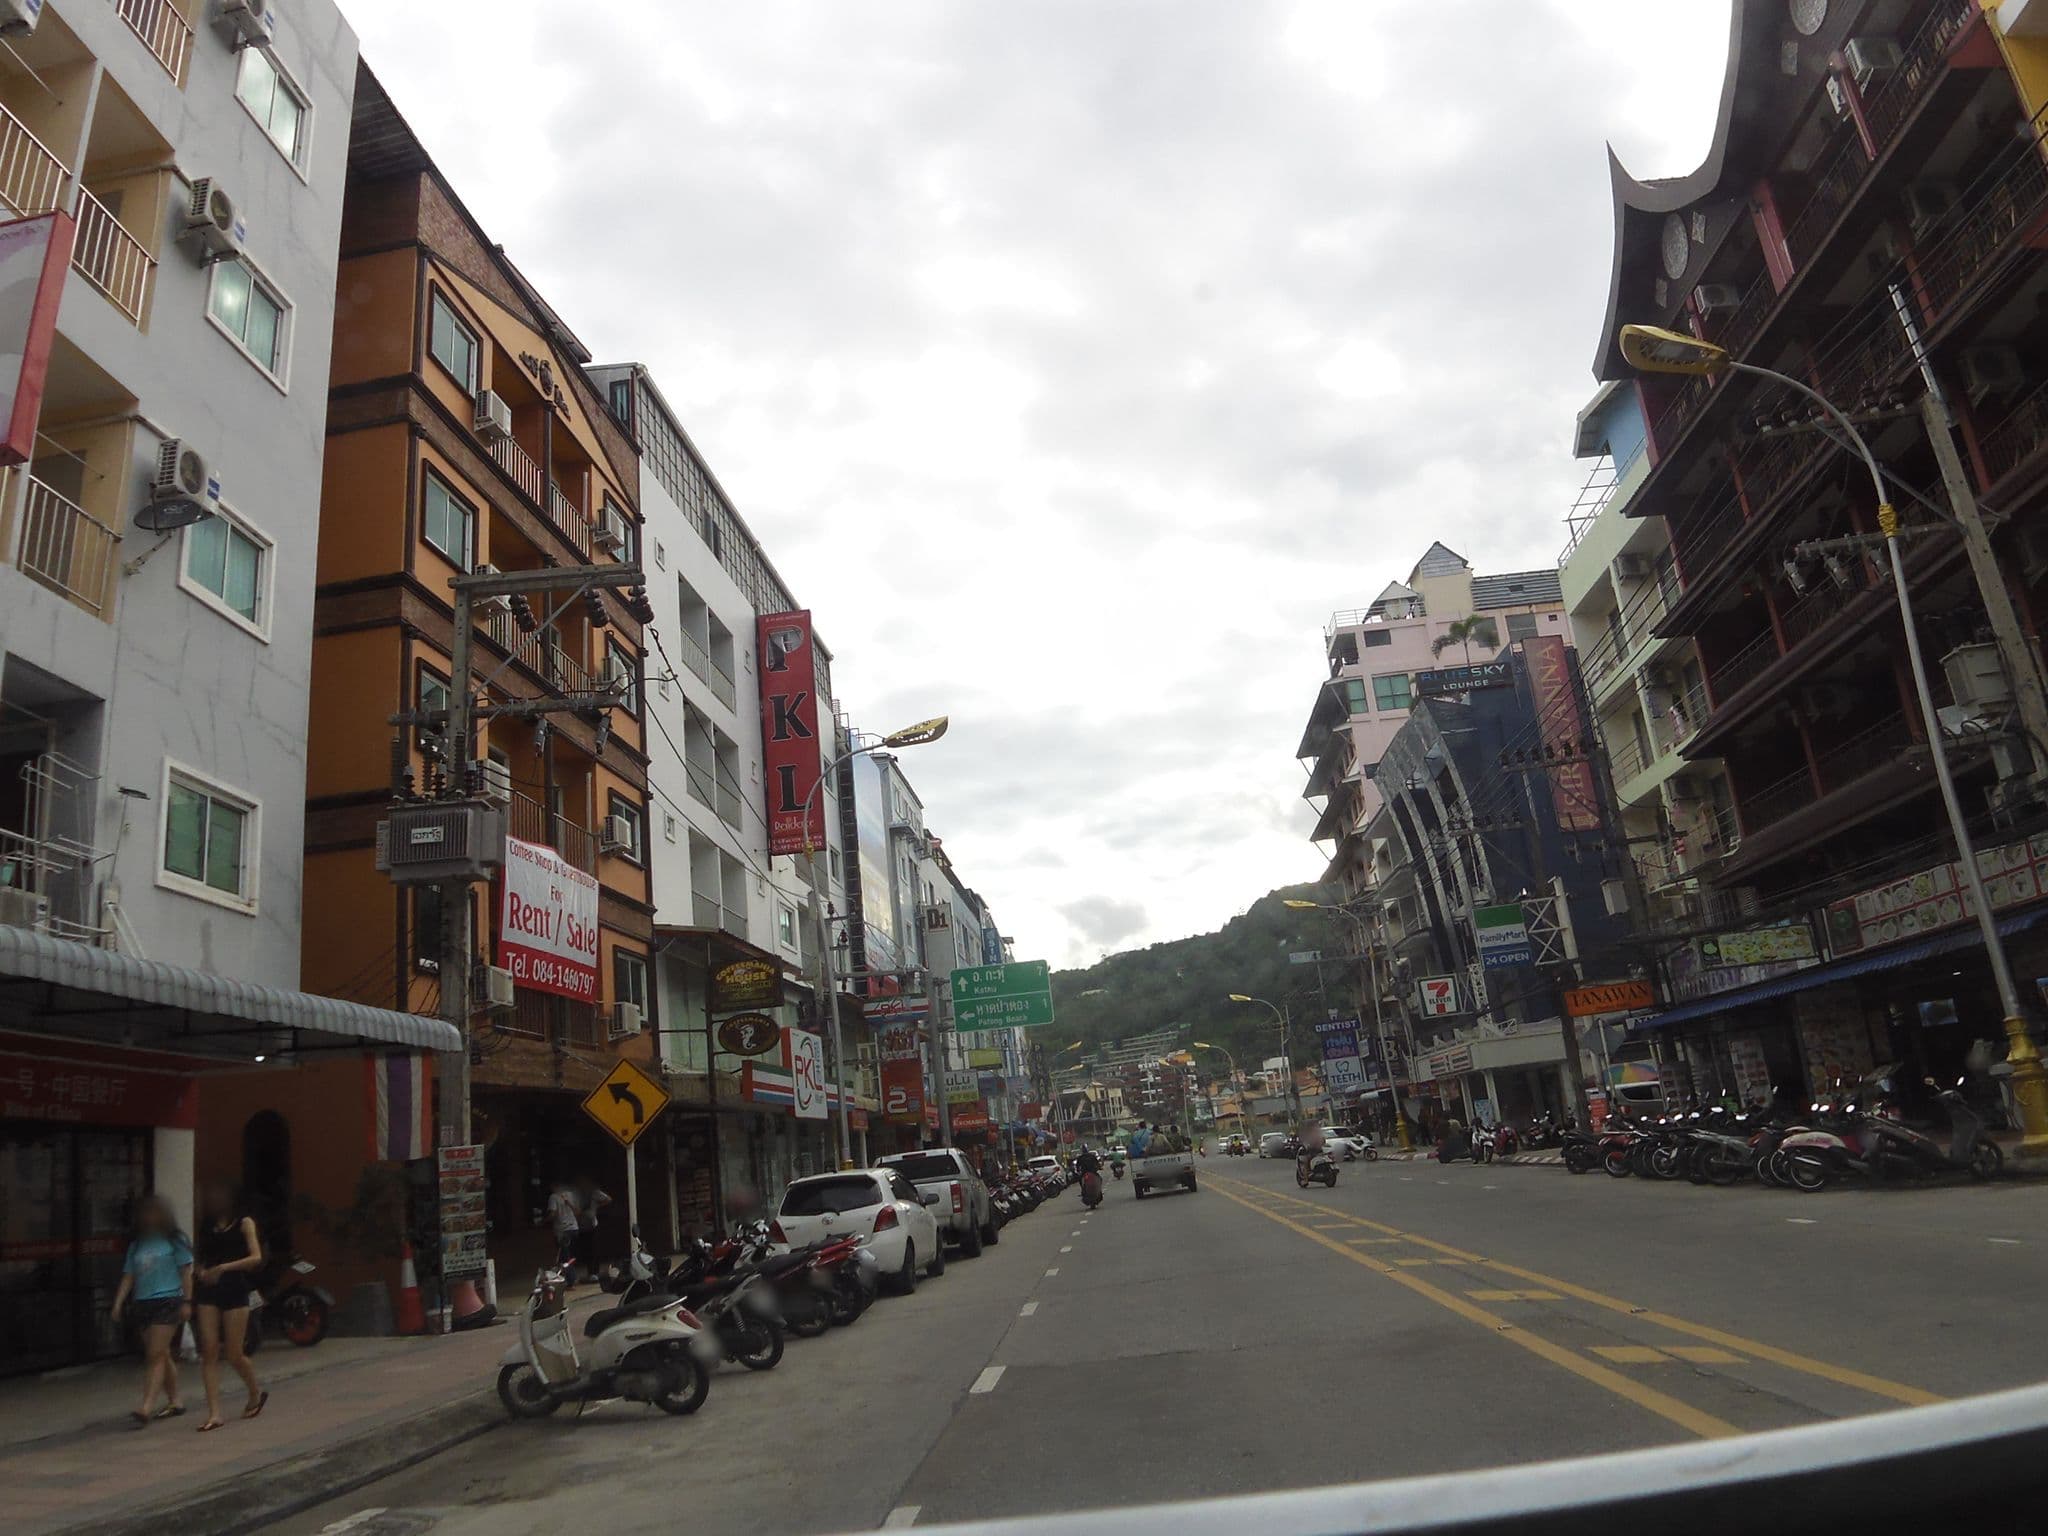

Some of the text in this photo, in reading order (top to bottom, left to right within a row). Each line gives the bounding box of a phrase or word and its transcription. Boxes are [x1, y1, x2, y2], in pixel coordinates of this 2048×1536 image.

[1443, 679, 1489, 690] LOUNGE
[767, 625, 812, 813] PKL
[509, 840, 533, 863] Coffee
[535, 852, 552, 875] Shop
[551, 886, 565, 904] For
[509, 892, 596, 956] Rent / Sale
[1480, 930, 1525, 943] FamilyMart
[506, 952, 529, 979] Tel.
[1485, 952, 1529, 965] 24 OPEN
[726, 971, 768, 984] HOUSE
[1036, 966, 1043, 976] 7
[1427, 981, 1450, 1014] 7
[1571, 983, 1649, 1008] TANAWAN
[1315, 1020, 1358, 1033] DENTIST
[795, 1055, 823, 1091] PKL
[1330, 1072, 1361, 1083] TEETH
